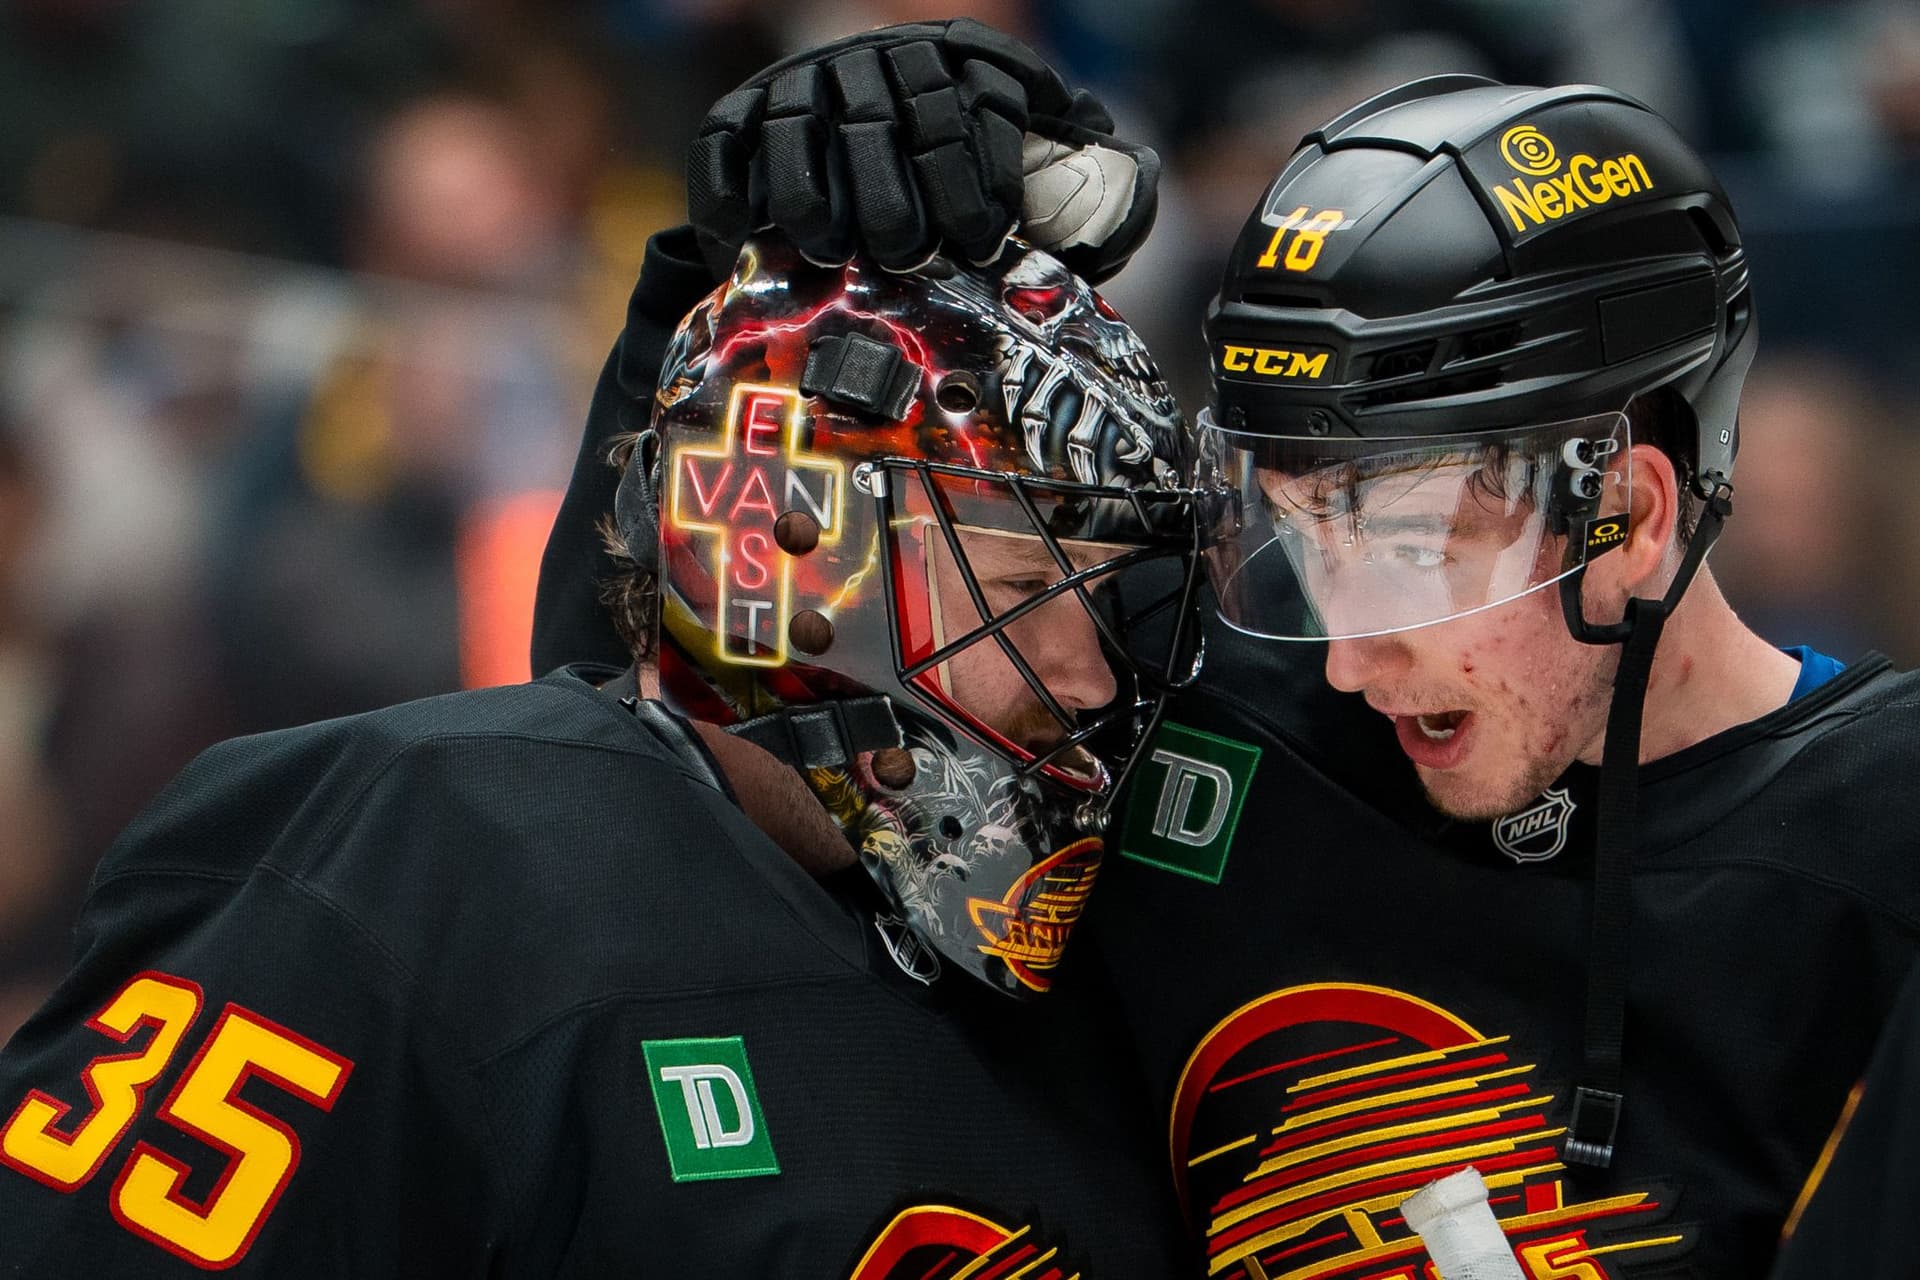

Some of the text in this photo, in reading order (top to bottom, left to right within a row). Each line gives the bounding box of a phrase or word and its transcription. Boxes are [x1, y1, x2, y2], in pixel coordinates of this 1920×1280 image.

[1494, 151, 1654, 233] NexGen
[1256, 206, 1344, 273] 18
[1222, 344, 1330, 380] CCM
[1587, 531, 1626, 546] OAKLEY
[1151, 748, 1234, 848] TD
[1507, 808, 1557, 841] NHL
[0, 970, 355, 1271] 35
[661, 1064, 755, 1149] TD
